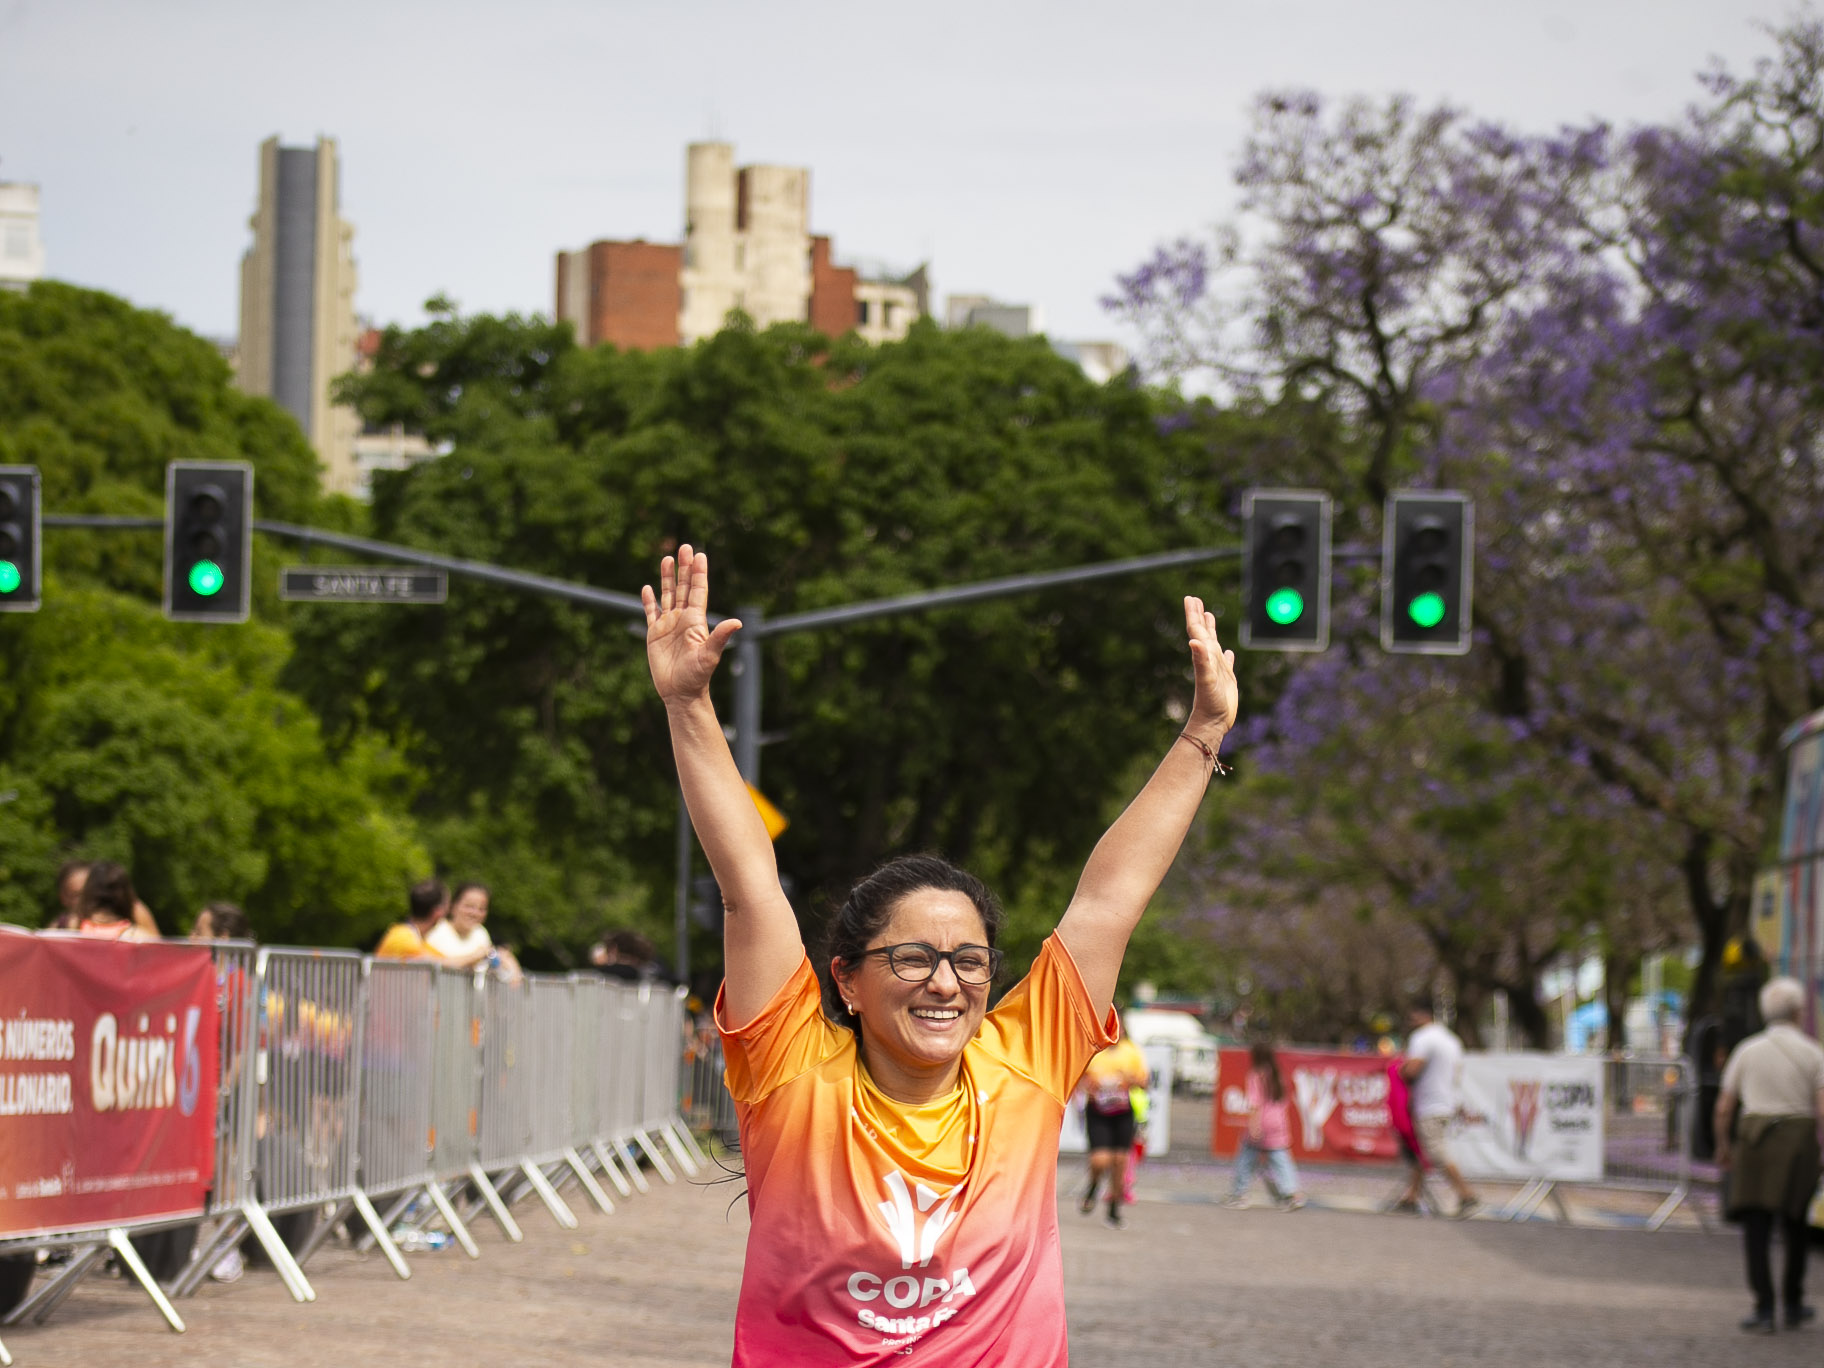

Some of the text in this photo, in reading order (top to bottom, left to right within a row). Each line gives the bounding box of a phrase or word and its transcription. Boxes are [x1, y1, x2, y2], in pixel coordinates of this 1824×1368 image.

[5, 1007, 76, 1061] NÚMEROS
[91, 1012, 176, 1112] Quini
[179, 1005, 201, 1117] 6
[847, 1268, 977, 1309] COPA
[857, 1308, 930, 1334] Santa
